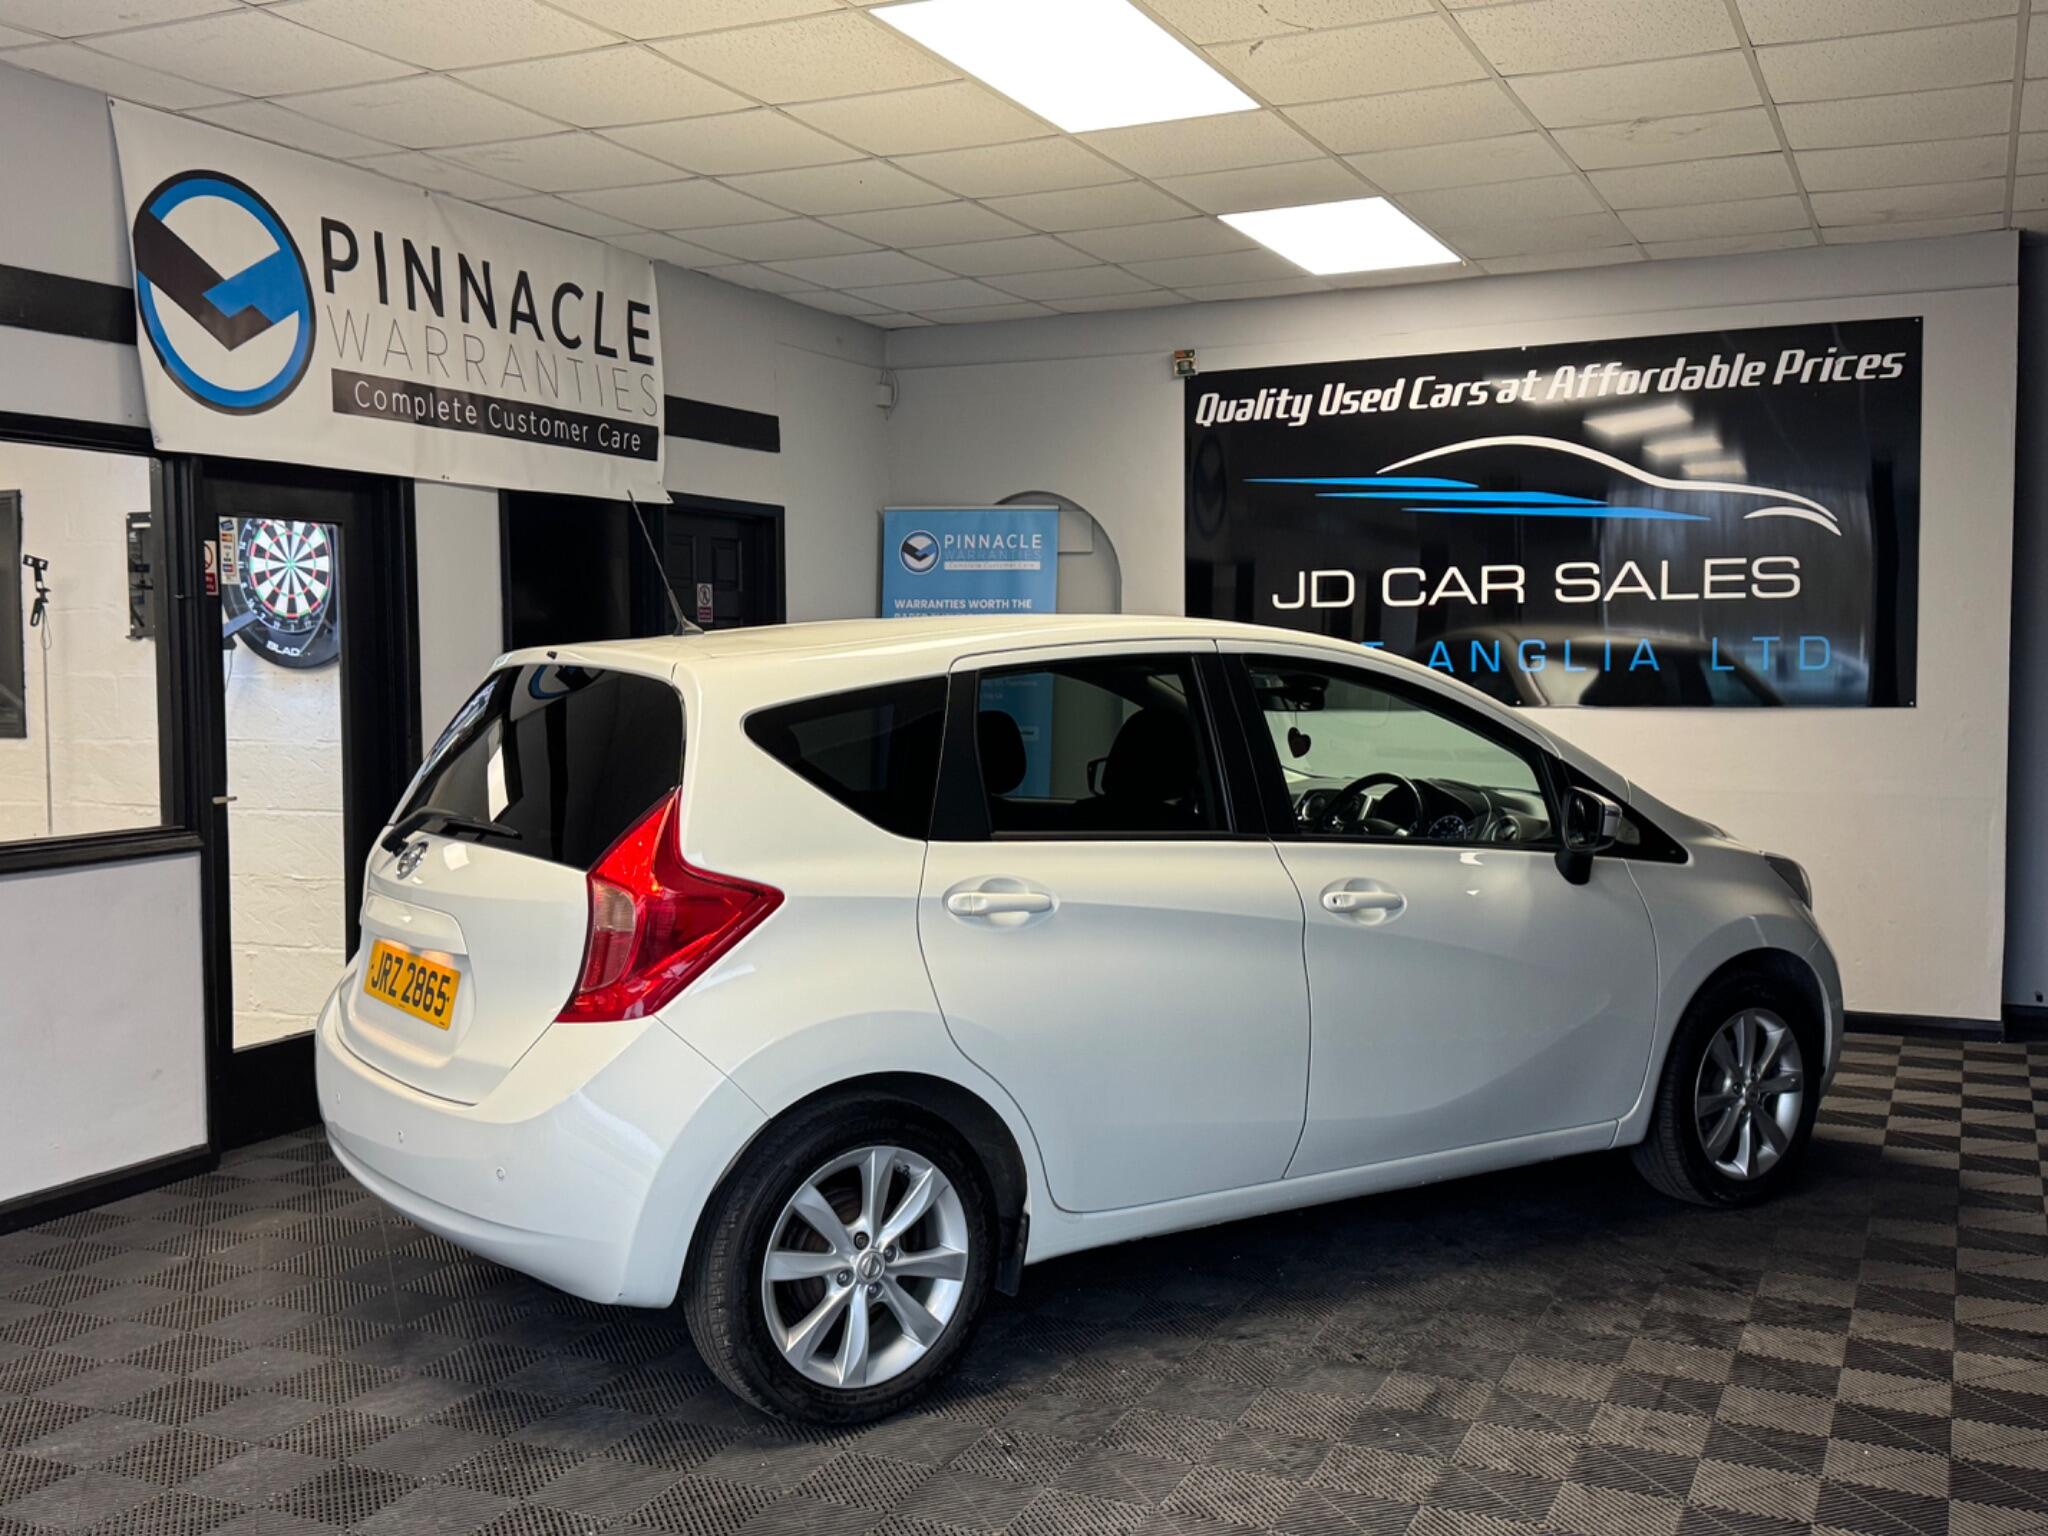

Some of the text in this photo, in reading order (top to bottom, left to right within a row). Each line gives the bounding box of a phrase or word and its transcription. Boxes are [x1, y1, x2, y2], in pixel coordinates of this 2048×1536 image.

[321, 216, 655, 366] PINNACLE
[326, 304, 658, 418] WARRANTIES
[1195, 347, 1907, 427] Quality Used Cars at Affordable Prices
[354, 380, 641, 451] Complete Customer Care
[944, 534, 1043, 549] PINNACLE
[895, 599, 1033, 609] WARRANTIES WORTH THE
[1271, 555, 1801, 610] JD CAR SALES
[1427, 635, 1832, 673] ANGLIA LTD
[370, 950, 452, 1018] JRZ 2865
